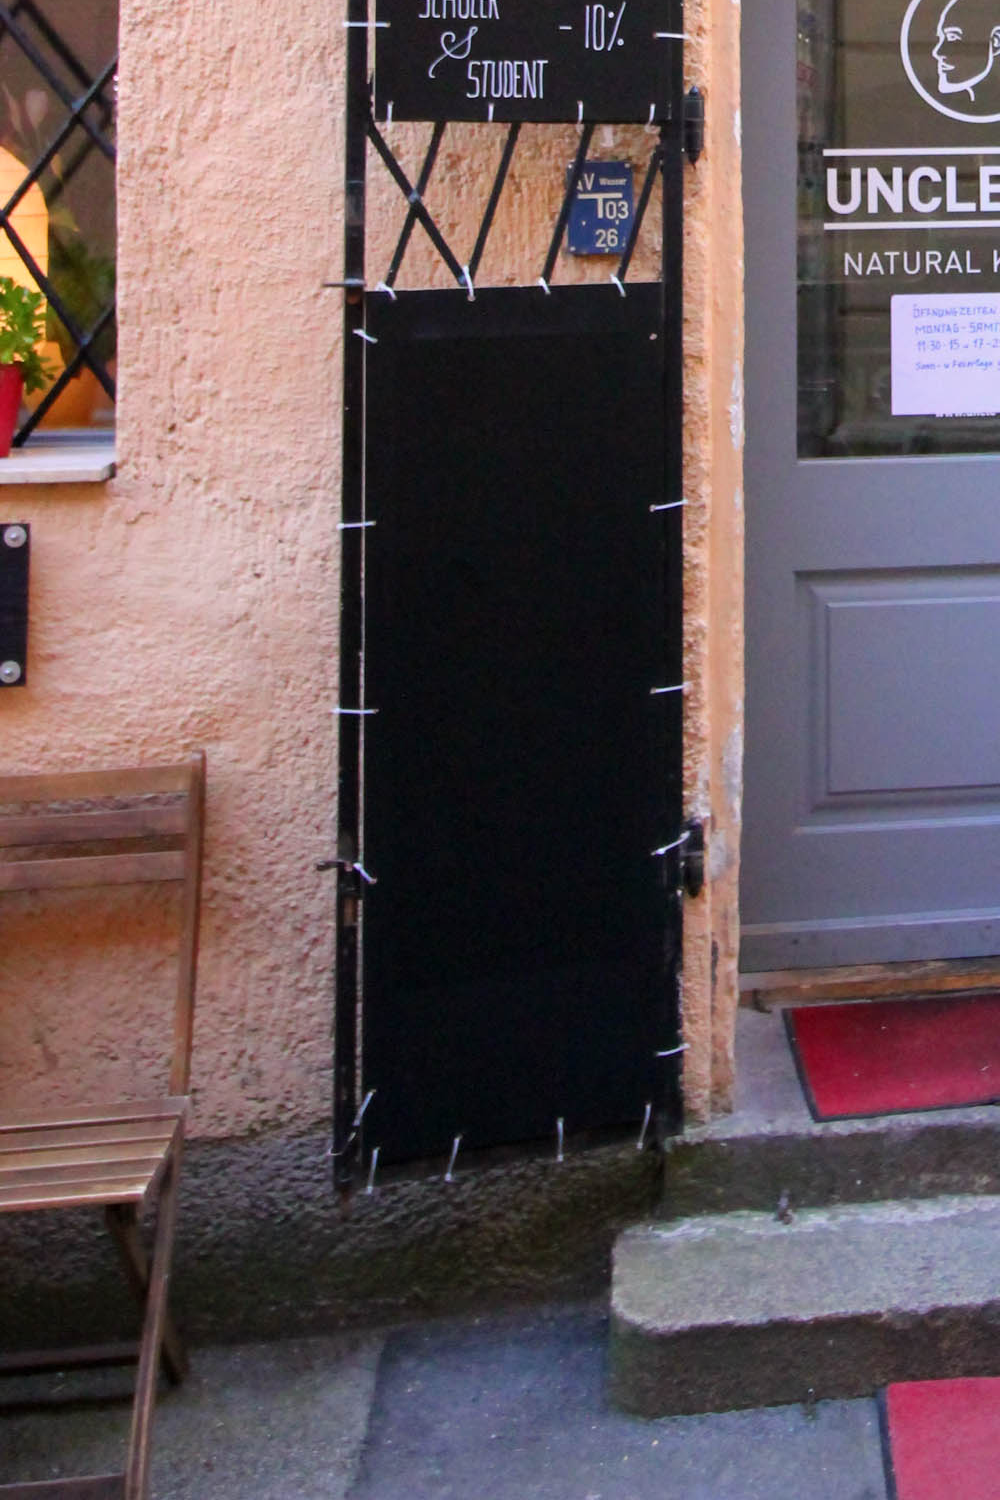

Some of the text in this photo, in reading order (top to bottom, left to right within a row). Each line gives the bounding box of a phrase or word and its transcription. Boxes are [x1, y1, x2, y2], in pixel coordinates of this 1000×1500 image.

[466, 60, 548, 99] STUDENT
[595, 228, 618, 248] 26
[844, 250, 981, 276] NATURAL
